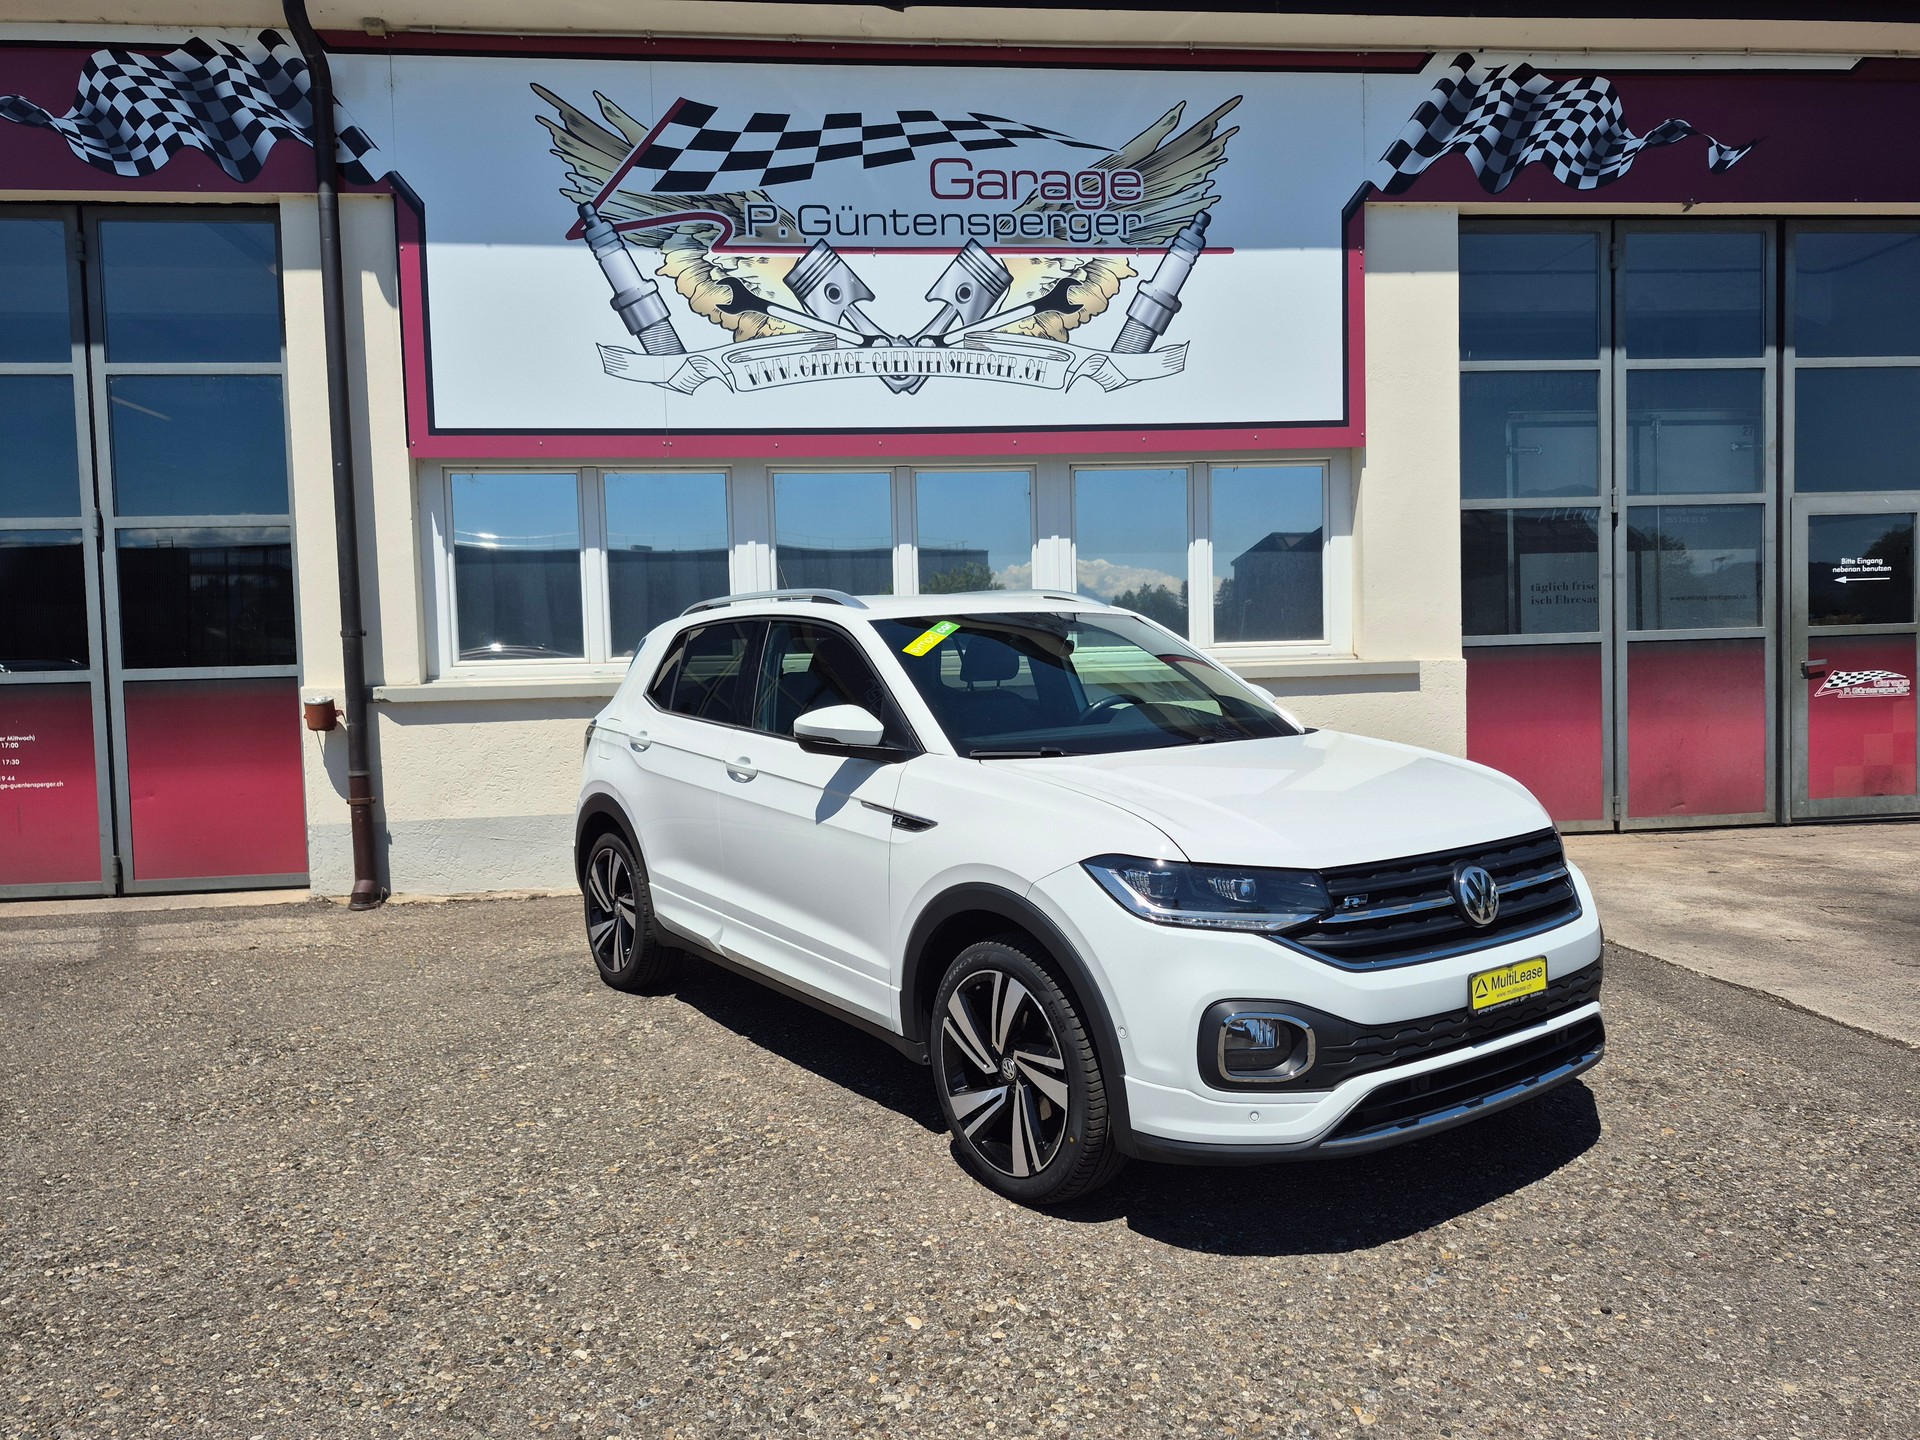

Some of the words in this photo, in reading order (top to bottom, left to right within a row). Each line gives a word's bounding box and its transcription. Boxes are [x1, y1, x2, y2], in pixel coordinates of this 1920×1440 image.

[930, 157, 1142, 210] Garage
[747, 204, 786, 236] P.
[798, 204, 1142, 242] Güntensperger
[744, 351, 1048, 386] WWW.GARAGE-GUENTENSPERGER.CH
[1857, 557, 1883, 565] Eingang
[1531, 581, 1569, 594] täglich
[1531, 595, 1552, 605] isch
[6, 734, 36, 742] Mittwoch)
[1491, 966, 1543, 991] MultiLease
[1496, 984, 1532, 998] www.multilease.ch
